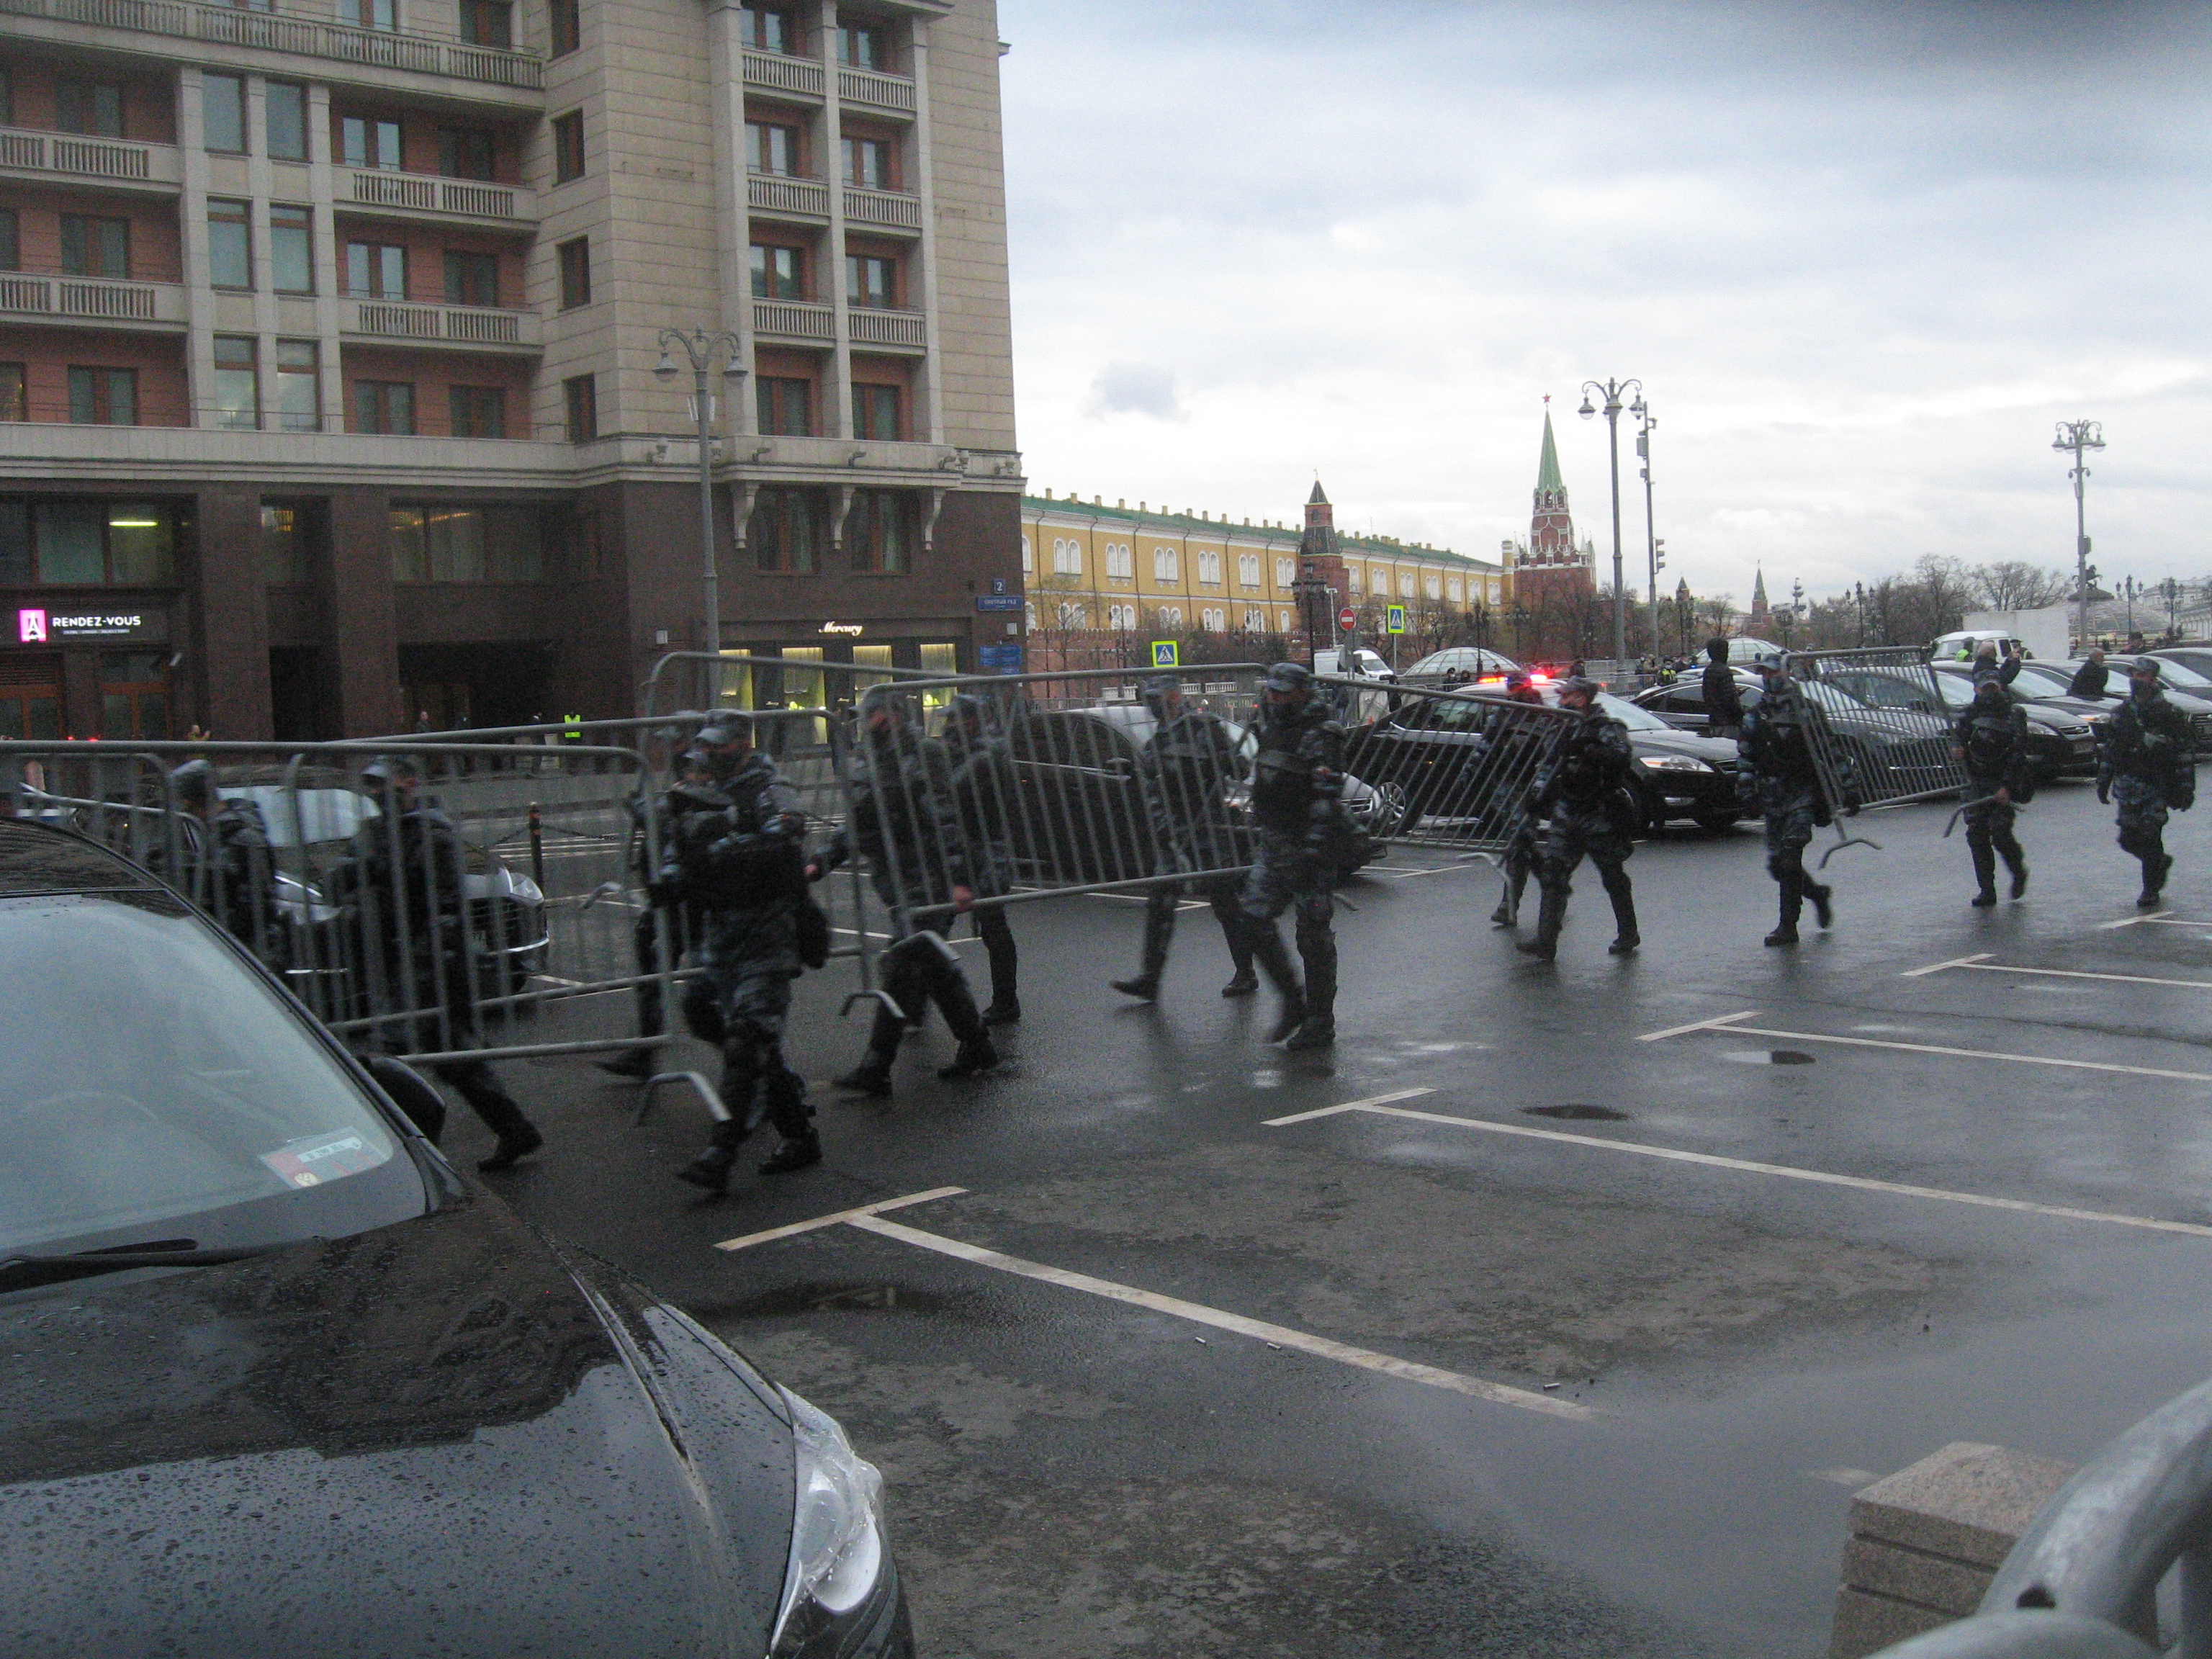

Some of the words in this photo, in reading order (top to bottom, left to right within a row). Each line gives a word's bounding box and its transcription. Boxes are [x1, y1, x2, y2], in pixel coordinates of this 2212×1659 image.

[997, 581, 1003, 591] 2
[52, 616, 142, 627] RENDEZ-VOUS
[818, 621, 863, 637] Mercury
